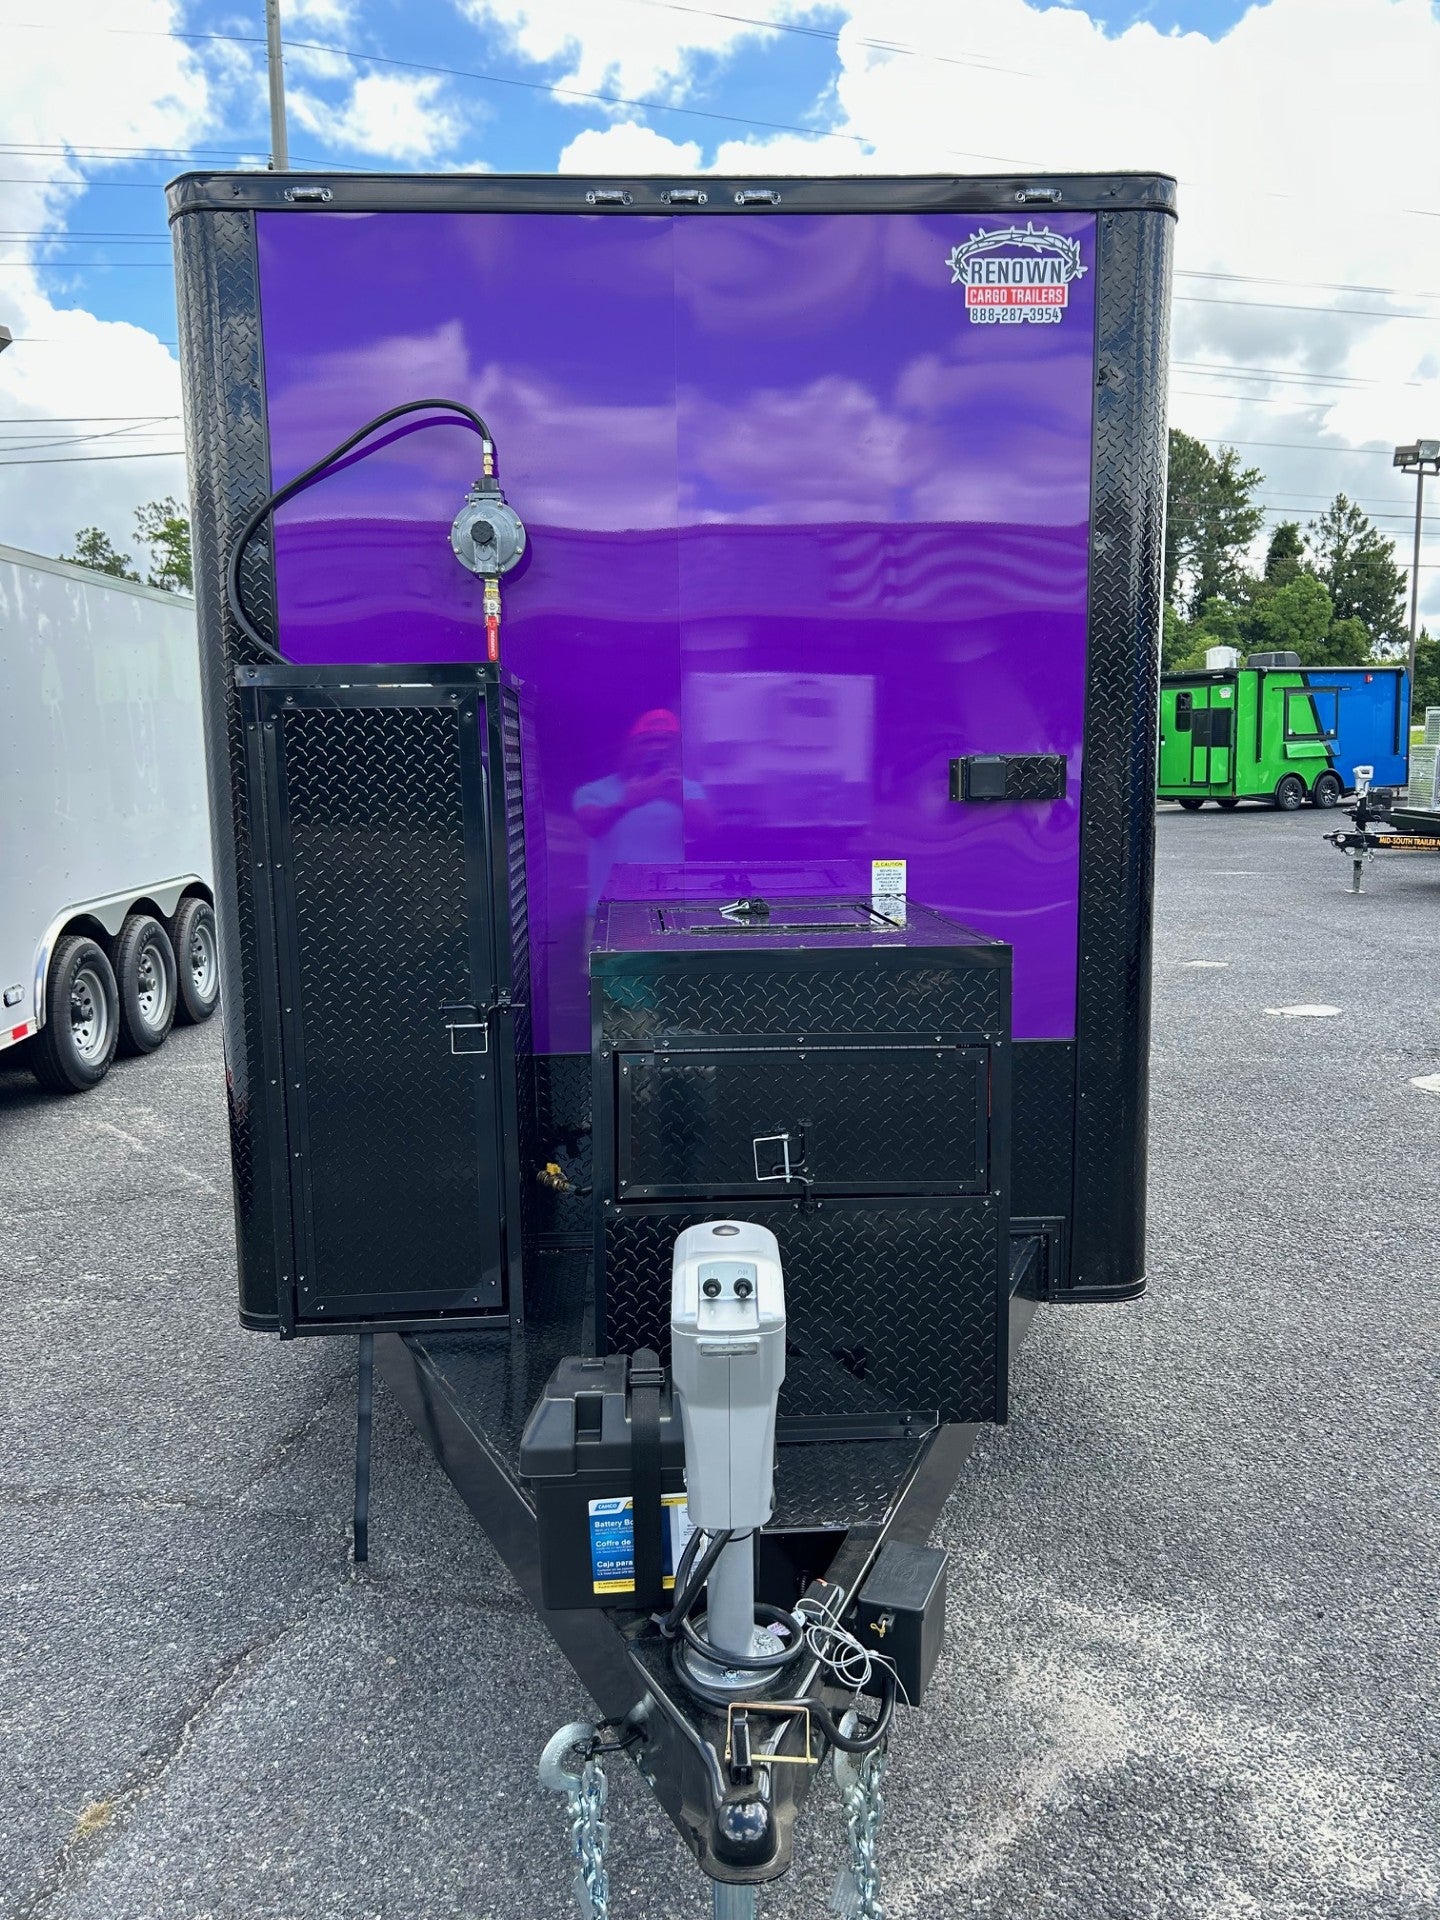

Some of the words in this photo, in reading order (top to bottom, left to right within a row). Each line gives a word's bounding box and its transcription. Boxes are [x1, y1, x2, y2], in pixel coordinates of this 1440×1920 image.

[971, 260, 1062, 284] RENOWN
[969, 288, 1008, 304] CARGO
[1011, 288, 1063, 304] TRAILERS
[971, 307, 1059, 321] 888-287-3954
[1379, 836, 1413, 845] MID-SOUTH
[1414, 838, 1436, 846] TRAILER
[594, 1520, 623, 1529] Battery
[595, 1540, 620, 1548] Coffre
[596, 1561, 615, 1569] Caja
[615, 1560, 634, 1568] para
